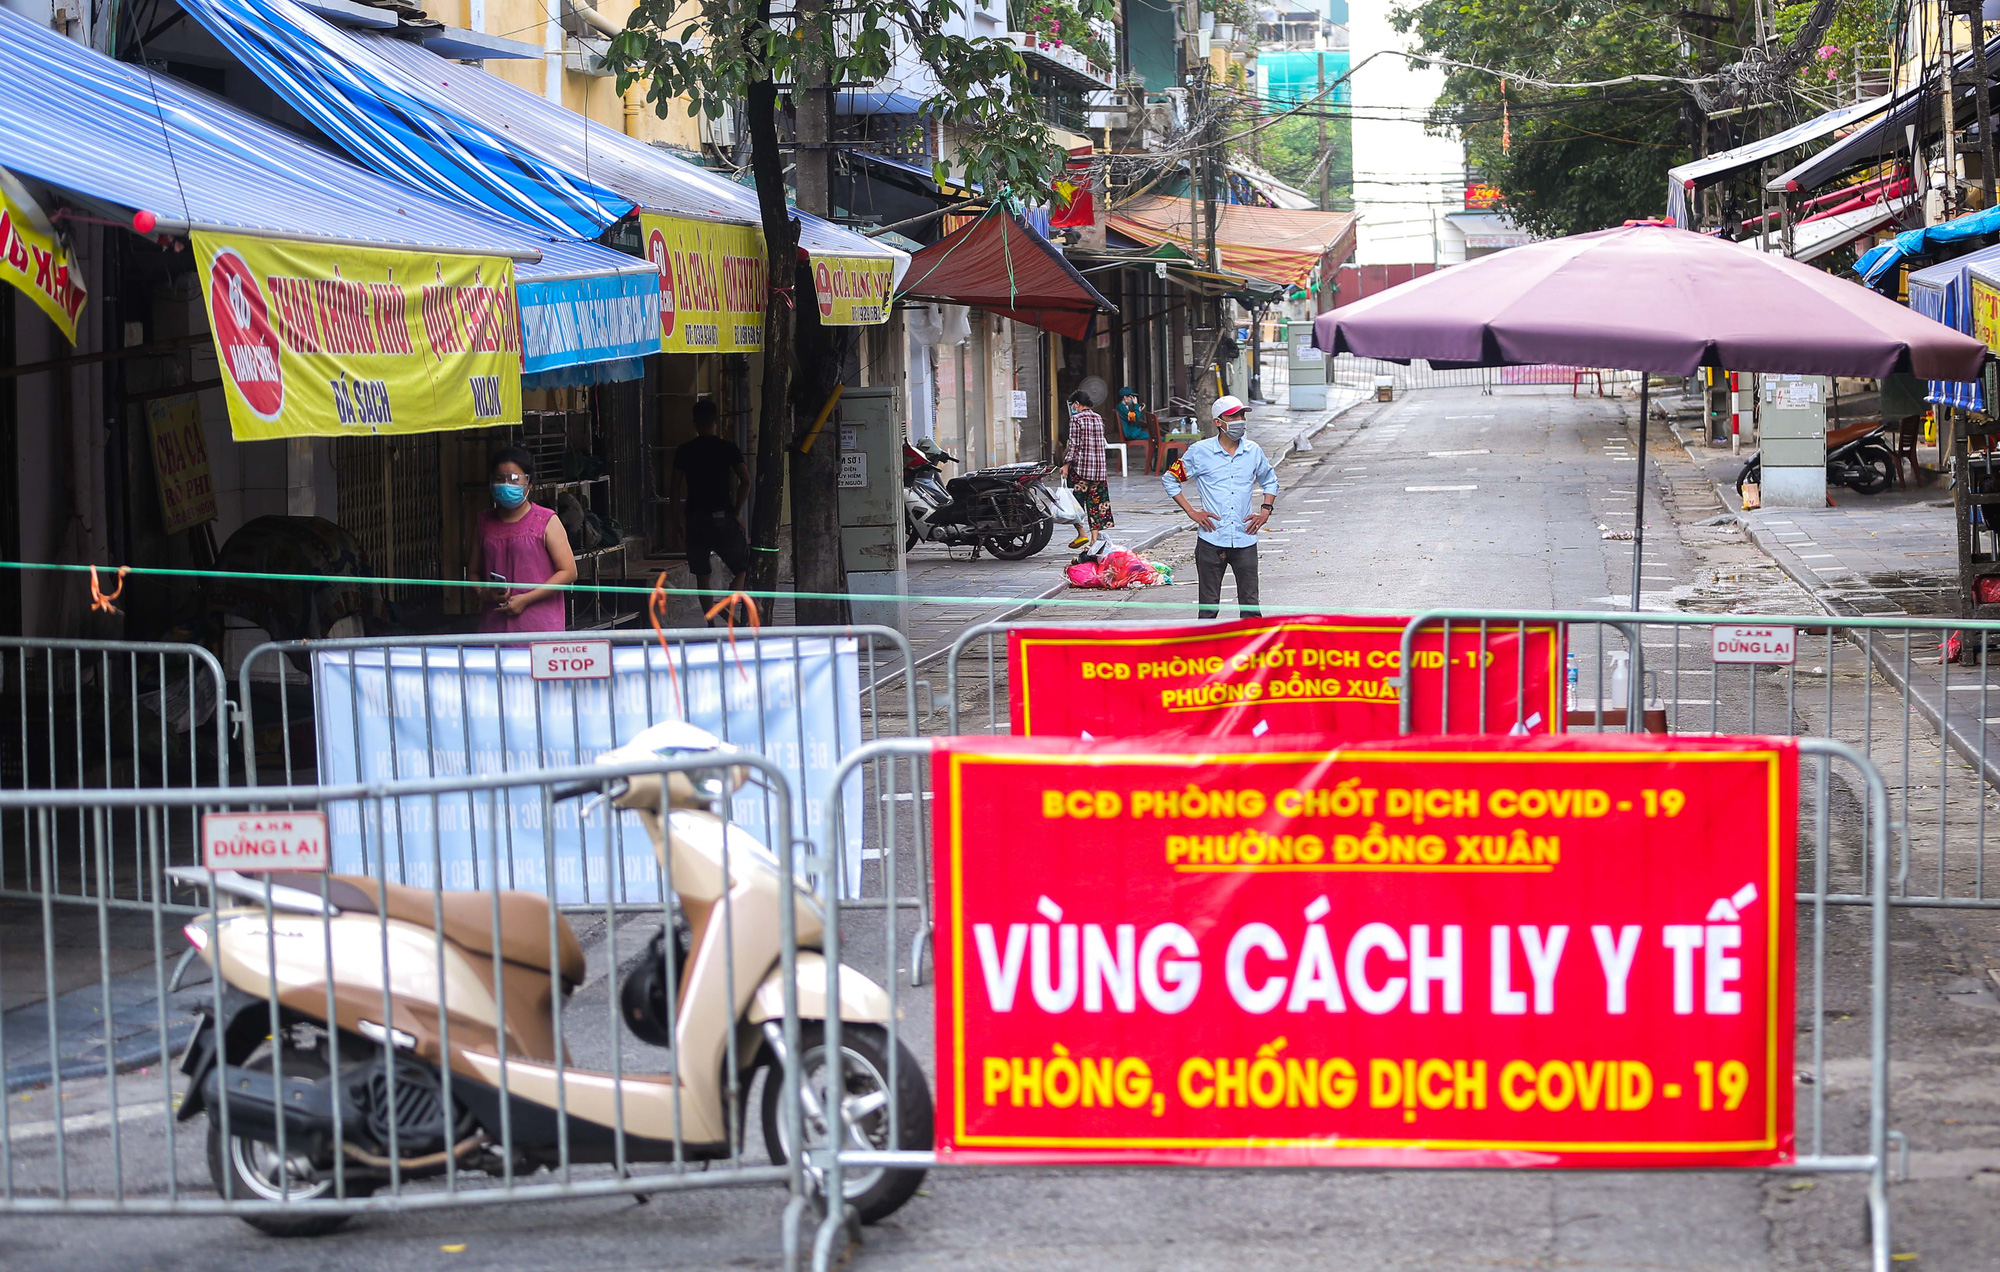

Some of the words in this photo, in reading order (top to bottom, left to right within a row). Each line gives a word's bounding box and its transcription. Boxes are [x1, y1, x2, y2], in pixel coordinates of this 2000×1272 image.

[267, 275, 323, 354] THAN
[313, 263, 378, 355] KHÔNG
[369, 268, 415, 355] KHÓI
[330, 371, 358, 424] ĐÁ
[352, 379, 393, 434] SẠCH
[469, 375, 502, 418] NILON
[548, 658, 595, 672] STOP
[552, 645, 588, 653] POLICE
[1081, 661, 1131, 680] BCĐ
[1137, 655, 1225, 680] PHÒNG
[1230, 642, 1297, 672] CHỐT
[1302, 648, 1361, 671] DỊCH
[1718, 638, 1761, 653] DỪNG
[1764, 642, 1789, 656] LẠI
[1161, 681, 1263, 708] PHƯỜNG
[1268, 670, 1342, 698] ĐỒNG
[1347, 676, 1401, 699] XUÂ
[1042, 789, 1123, 819] BCĐ
[1130, 783, 1267, 819] PHÒNG
[1274, 776, 1379, 818] CHỐT
[1385, 788, 1480, 825] DỊCH
[1487, 788, 1611, 819] COVID
[1616, 799, 1633, 811] -
[1640, 788, 1687, 819] 19
[1165, 827, 1325, 865] PHƯỜNG
[1332, 821, 1448, 864] ĐỒNG
[1453, 828, 1561, 864] XUÂN
[972, 894, 1202, 1014] VÙNG
[1225, 894, 1463, 1014] CÁCH
[1490, 924, 1570, 1014] LY
[1590, 924, 1643, 1014] Y
[1662, 882, 1758, 1014] TẾ
[983, 1042, 1166, 1118] PHÒNG,
[1177, 1035, 1358, 1109] CHỐNG
[1368, 1057, 1488, 1124] DỊCH
[1498, 1057, 1654, 1112] COVID
[1662, 1082, 1683, 1099] -
[1693, 1058, 1750, 1111] 19
